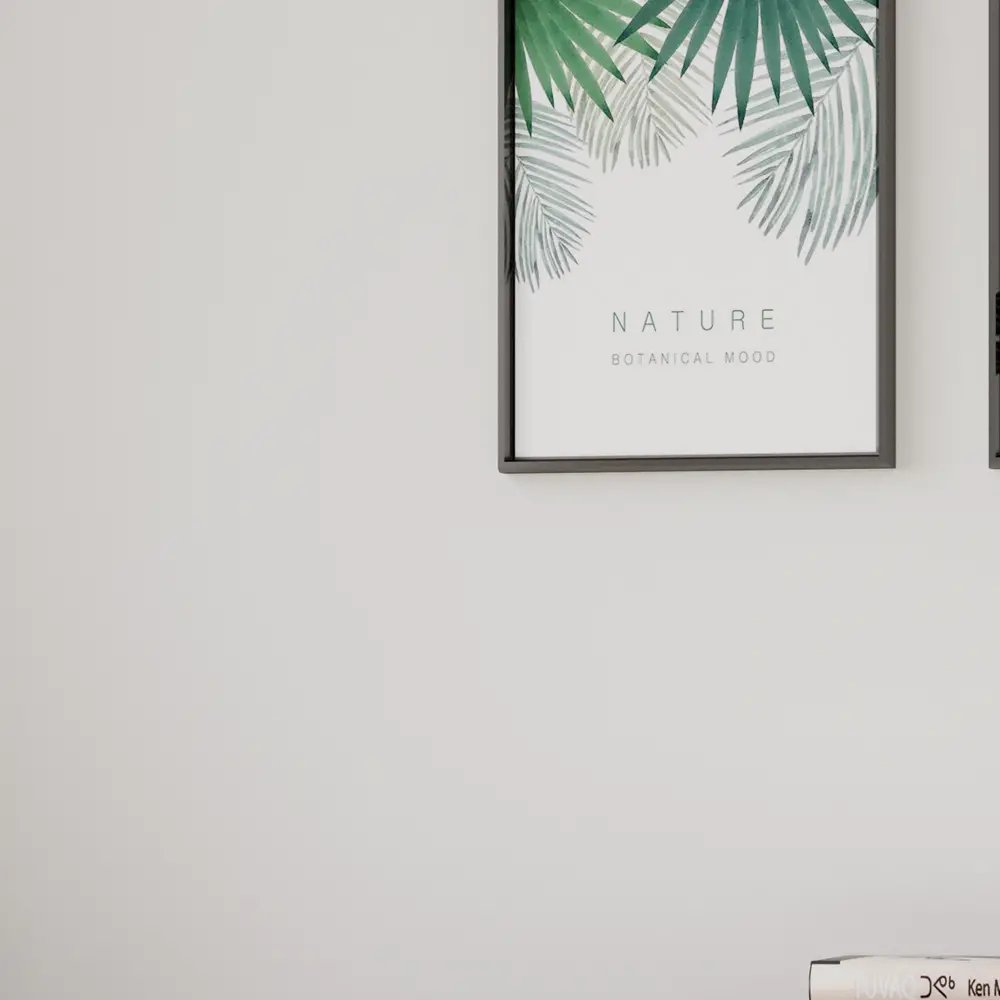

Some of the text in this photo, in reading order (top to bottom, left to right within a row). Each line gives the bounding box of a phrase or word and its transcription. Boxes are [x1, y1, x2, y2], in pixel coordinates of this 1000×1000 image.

[612, 309, 774, 332] NATURE
[611, 351, 776, 366] BOTANICAL MOOD
[968, 979, 991, 997] Ken
